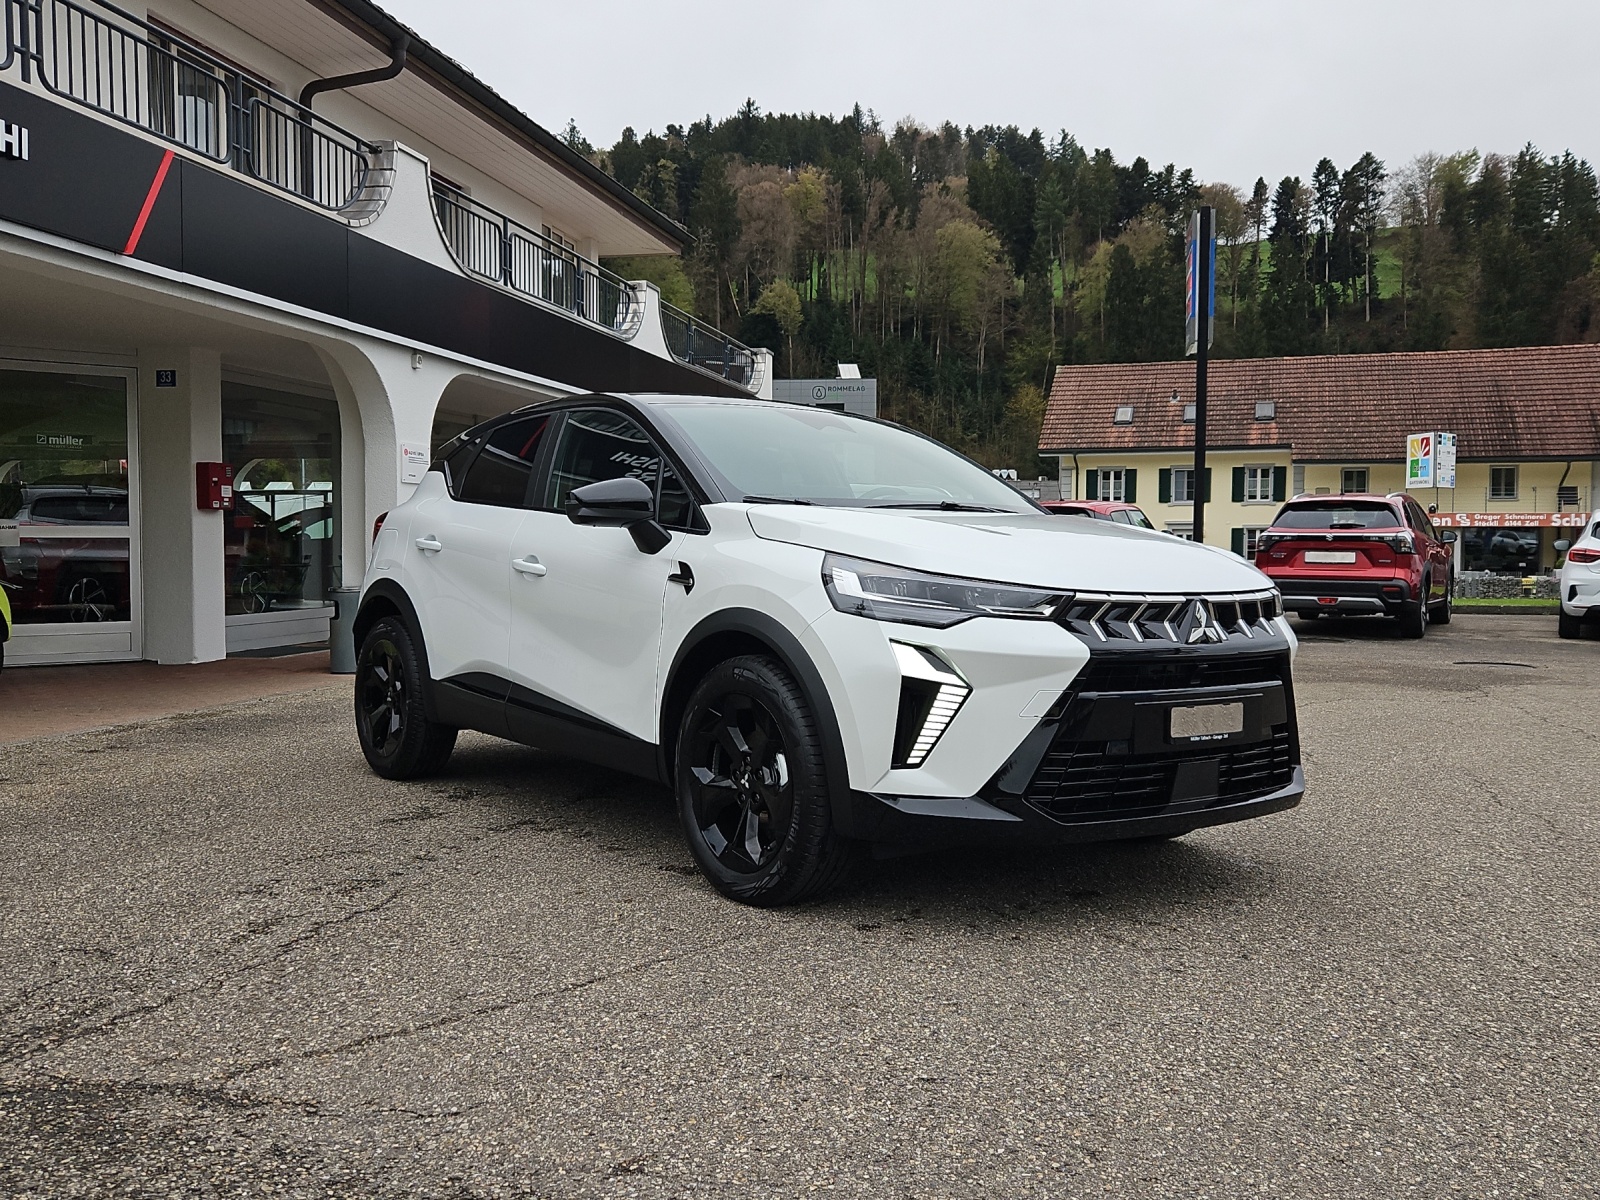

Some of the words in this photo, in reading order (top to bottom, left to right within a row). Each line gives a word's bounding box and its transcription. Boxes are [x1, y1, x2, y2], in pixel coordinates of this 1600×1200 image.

[160, 371, 172, 383] 33
[48, 434, 84, 446] müller
[1432, 517, 1452, 527] en
[1551, 513, 1587, 527] Schl
